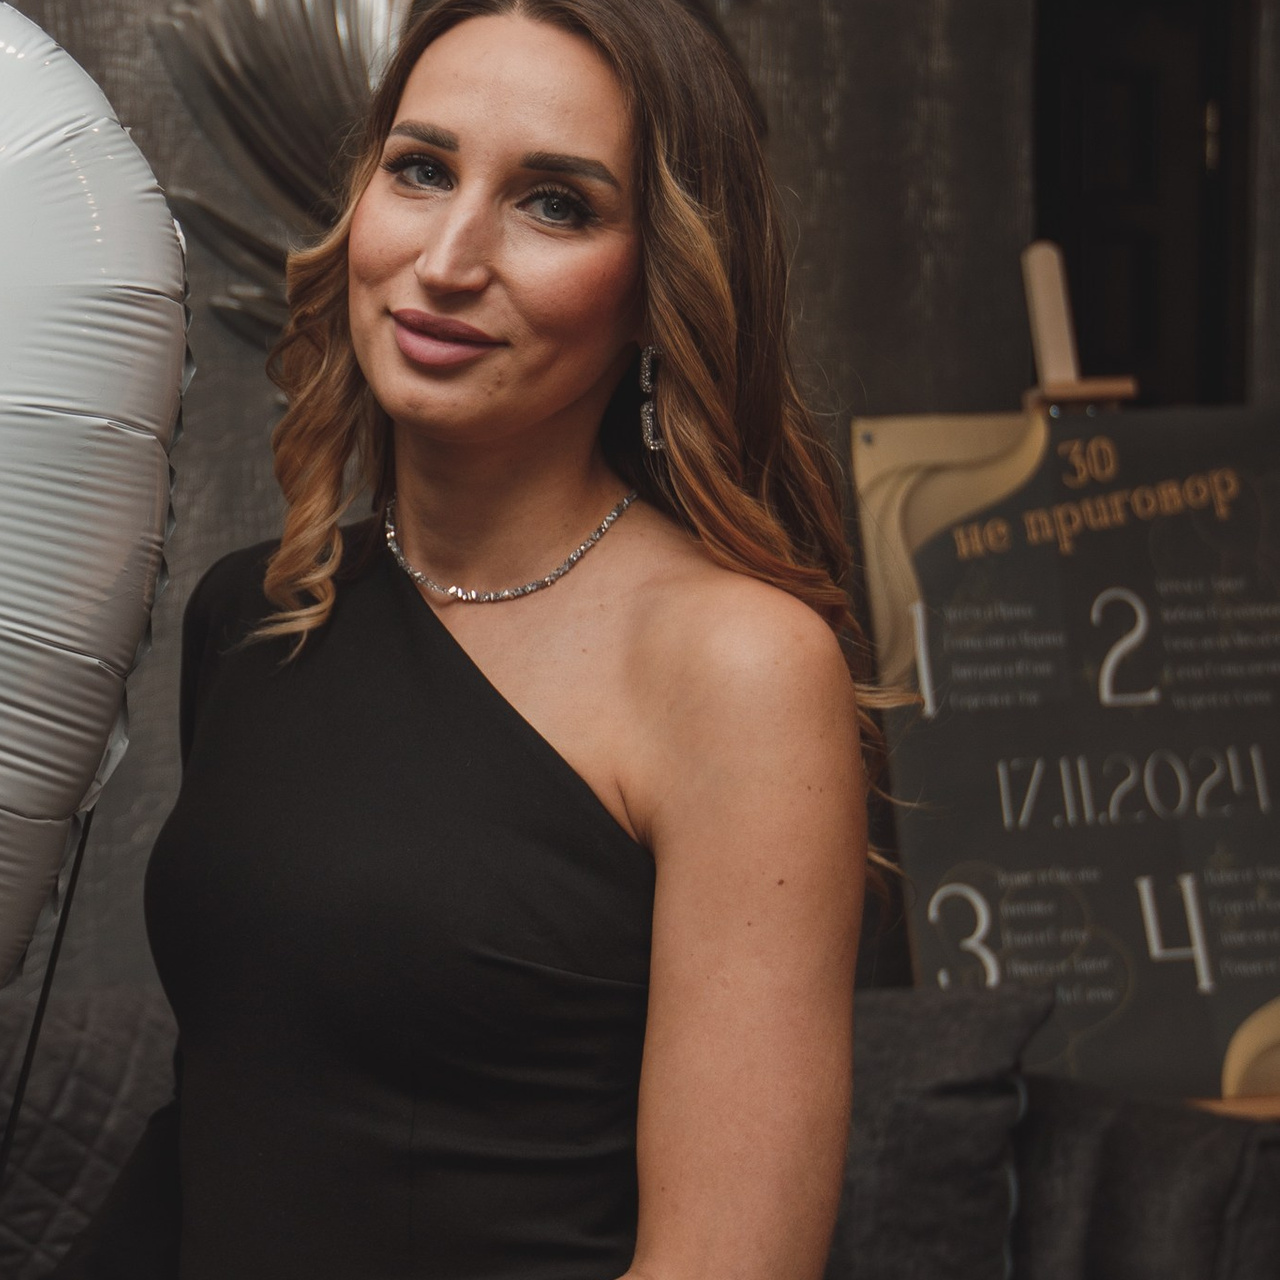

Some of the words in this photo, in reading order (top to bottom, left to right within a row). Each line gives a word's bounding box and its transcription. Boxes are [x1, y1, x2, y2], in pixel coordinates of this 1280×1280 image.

[953, 520, 1012, 561] не
[1023, 468, 1240, 556] приговор
[1057, 435, 1118, 490] 30
[1090, 586, 1161, 708] 2
[928, 882, 1000, 990] 3
[1135, 873, 1214, 994] 4
